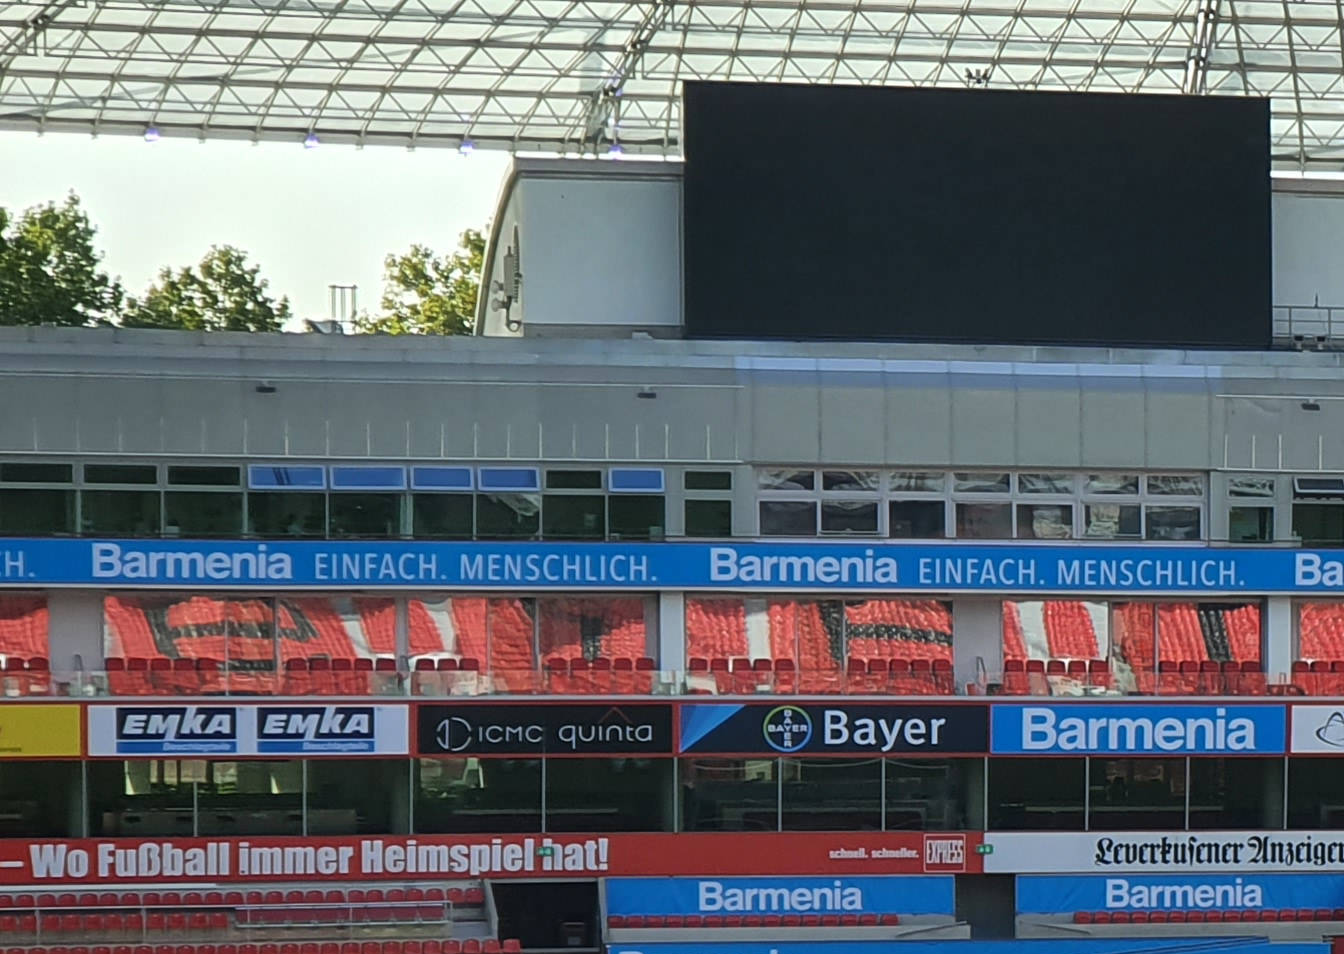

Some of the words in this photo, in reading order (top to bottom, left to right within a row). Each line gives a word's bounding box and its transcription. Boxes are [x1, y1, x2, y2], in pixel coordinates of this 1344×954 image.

[91, 543, 293, 579] Barmenia
[314, 552, 446, 580] EINFACH.
[461, 553, 658, 582] MENSCHLICH.
[710, 547, 897, 583] Barmenia
[919, 558, 1045, 585] EINFACH.
[1058, 558, 1246, 587] MENSCHLICH.
[558, 725, 653, 749] quinta
[824, 710, 946, 752] Bayer
[1022, 708, 1255, 750] Barmenia
[30, 844, 88, 877] Wo
[98, 843, 230, 877] Fußball
[239, 842, 353, 875] immer
[361, 839, 534, 875] Heimspiel
[542, 838, 608, 871] hat!
[699, 878, 862, 912] Barmenia
[1105, 878, 1263, 909] Barmenia
